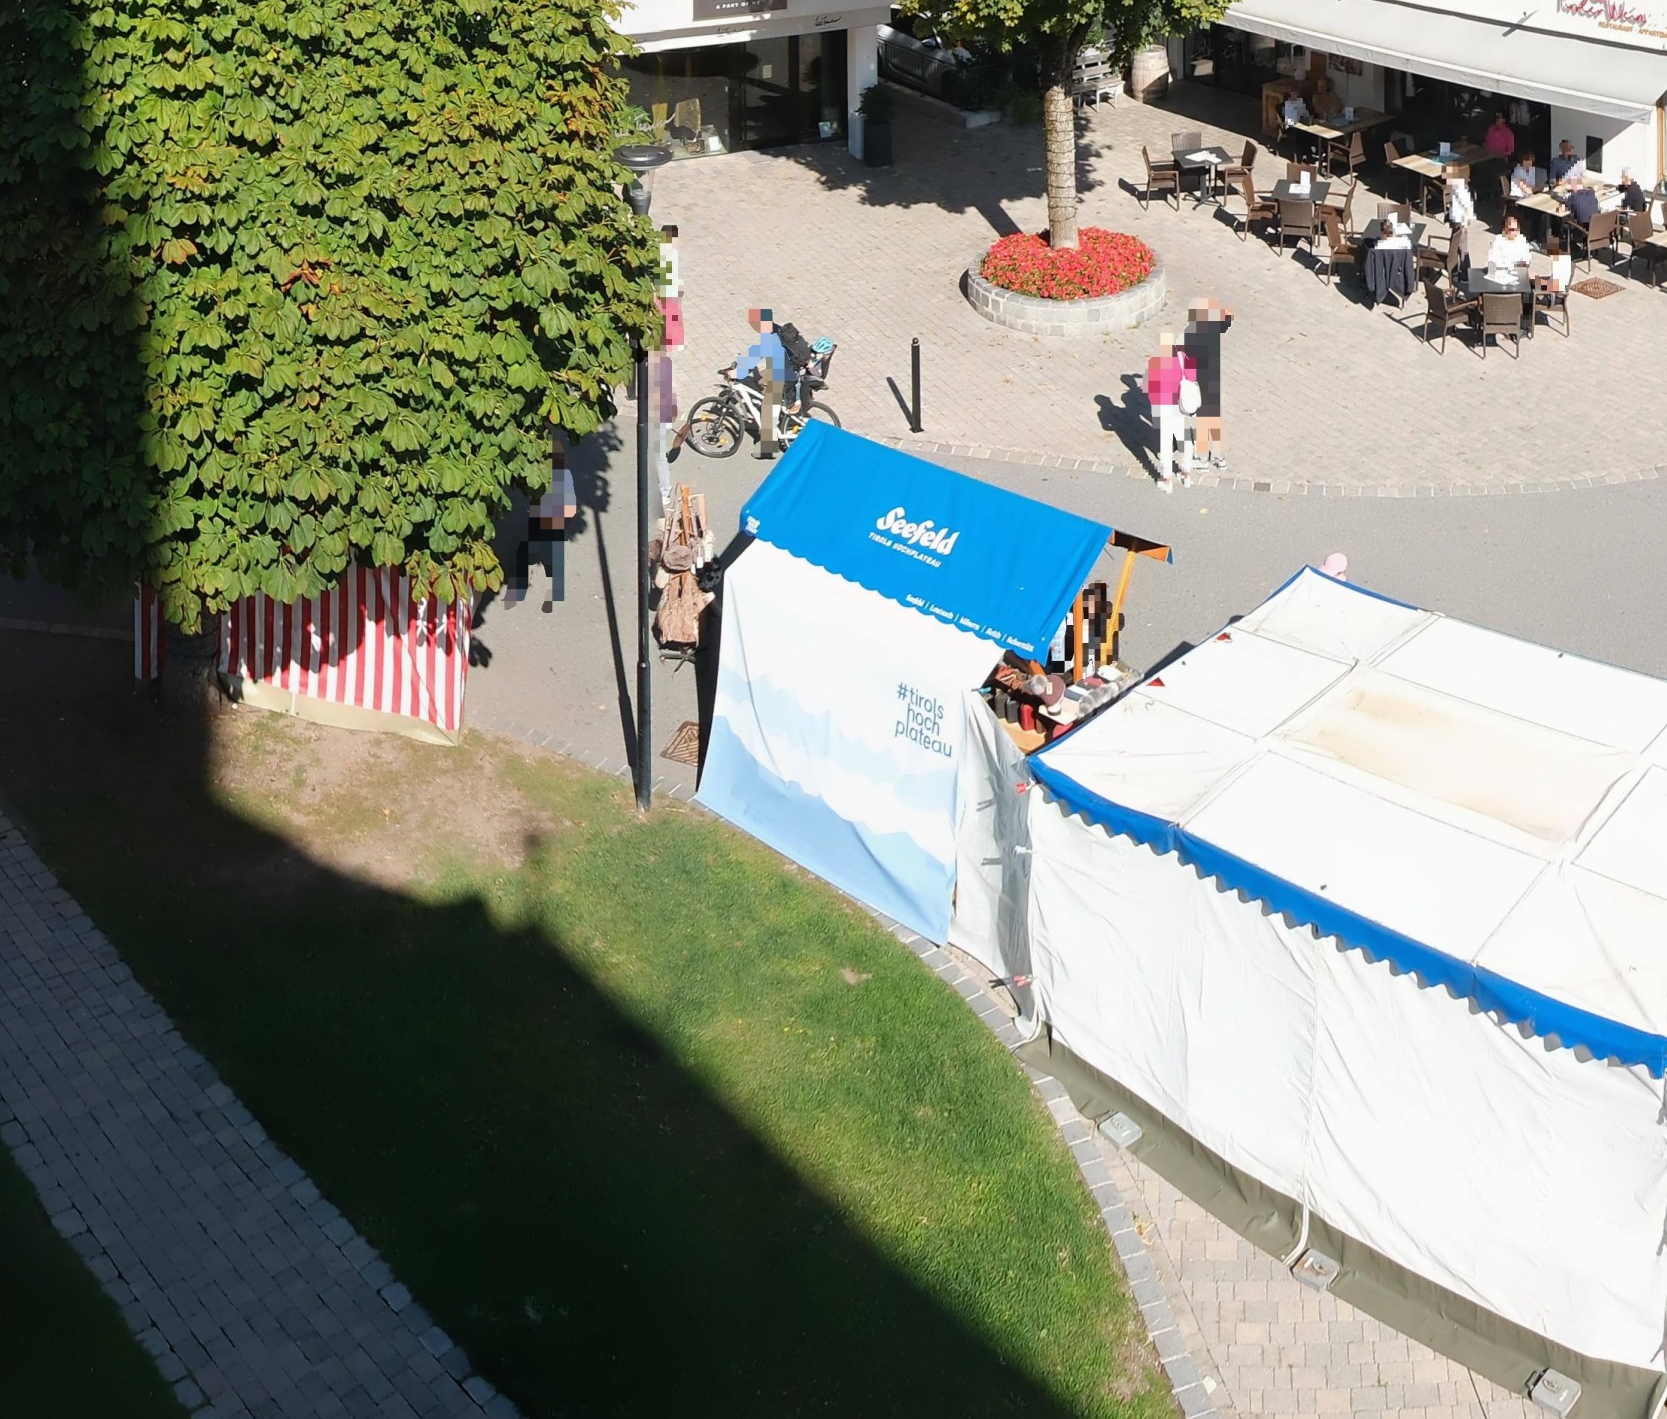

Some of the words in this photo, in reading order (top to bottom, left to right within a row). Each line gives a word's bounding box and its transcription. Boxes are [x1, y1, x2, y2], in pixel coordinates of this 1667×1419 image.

[867, 531, 893, 549] TIROLS
[892, 542, 942, 569] HOCHPLATEAU
[876, 506, 961, 556] Seefeld
[897, 681, 945, 720] #tirols
[907, 703, 941, 737] hoch
[894, 717, 953, 759] plateau
